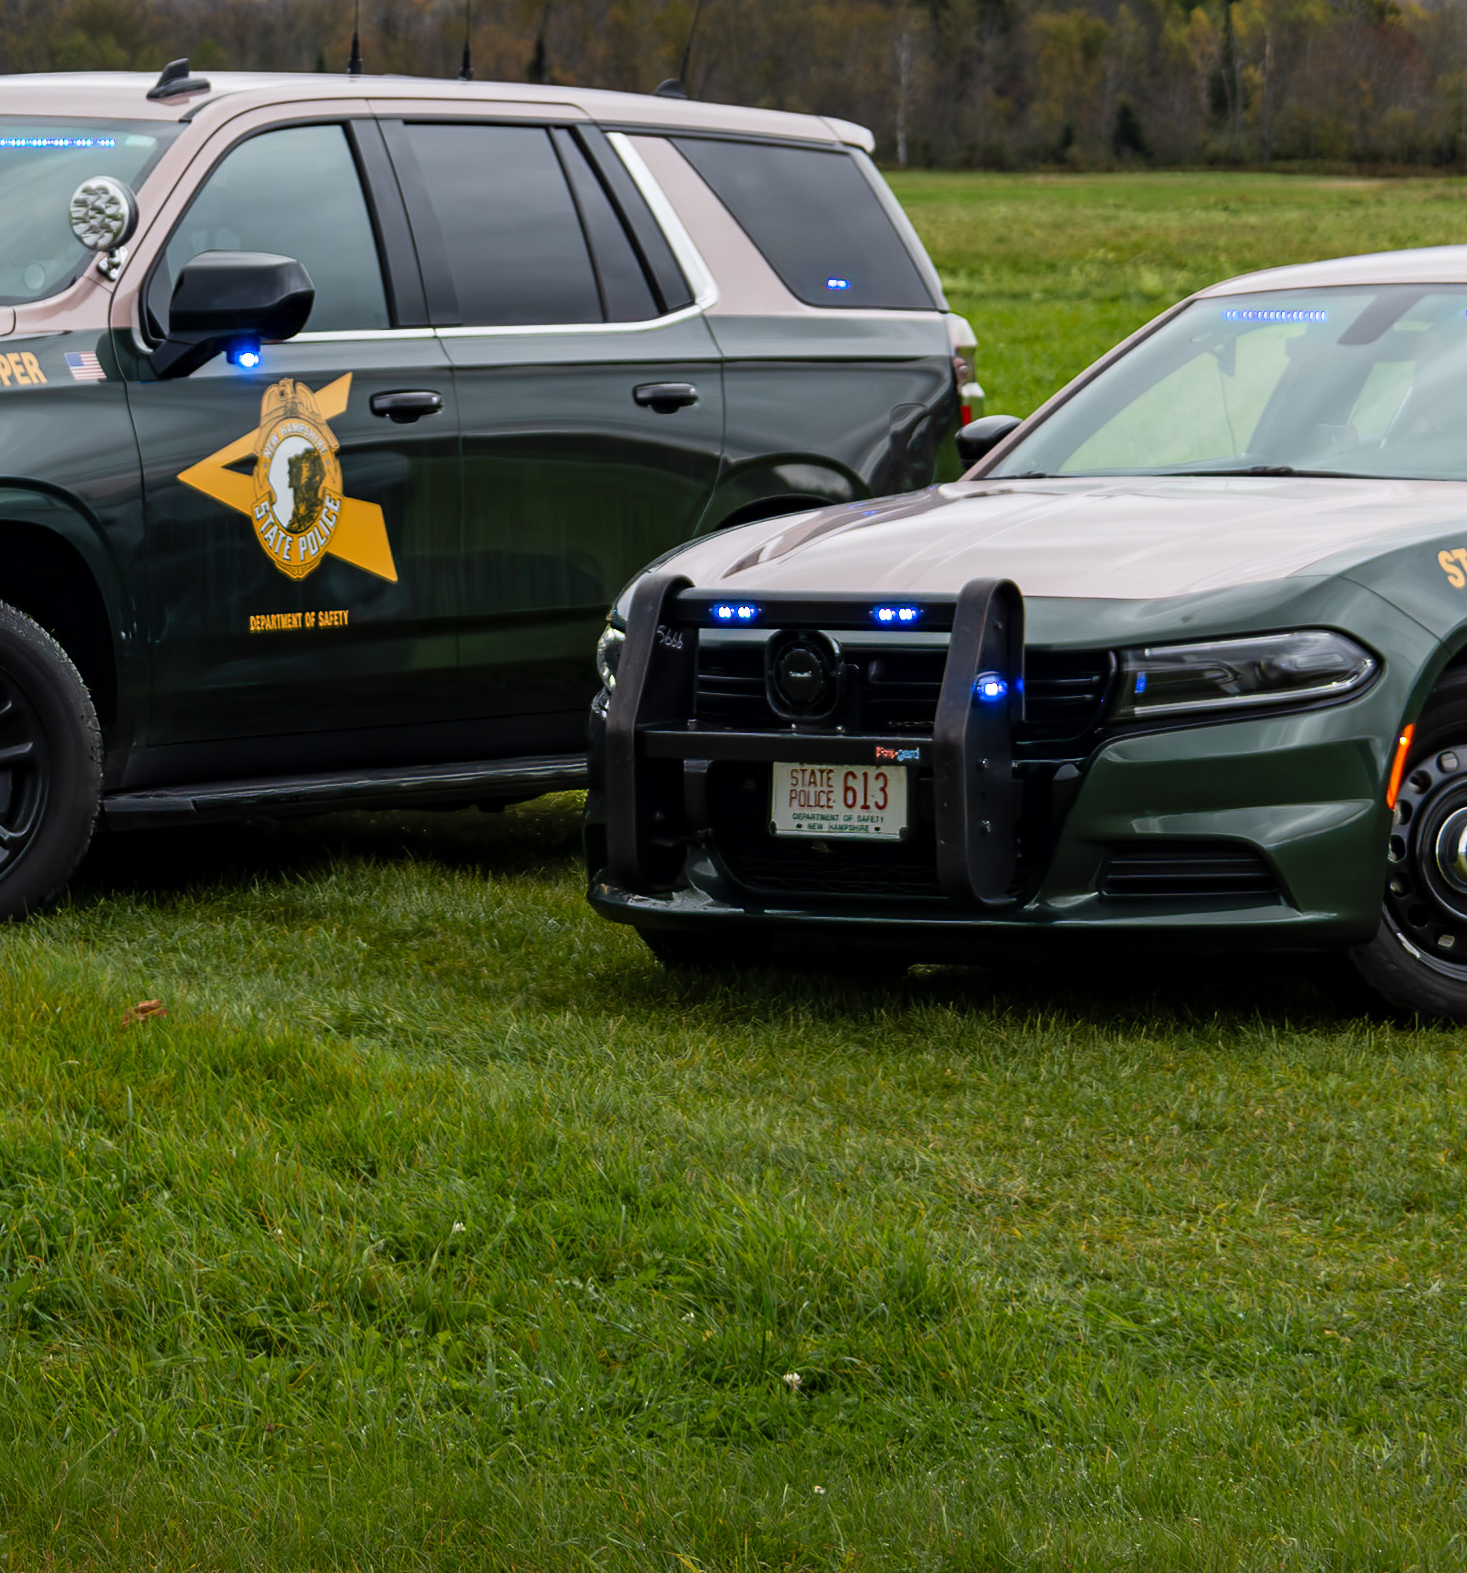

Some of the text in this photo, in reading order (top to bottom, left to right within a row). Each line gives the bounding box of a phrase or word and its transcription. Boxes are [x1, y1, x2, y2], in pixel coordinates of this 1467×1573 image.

[263, 422, 328, 459] NEW HAMPSHIRE
[254, 494, 342, 562] STATE POLICE
[249, 610, 349, 632] DEPARTMENT OF SAFETY
[789, 788, 834, 809] POLICE
[790, 768, 888, 810] STATE 613
[792, 812, 884, 823] DEPARTMENT OF SAFETY
[828, 823, 870, 832] HAMPSHIRE
